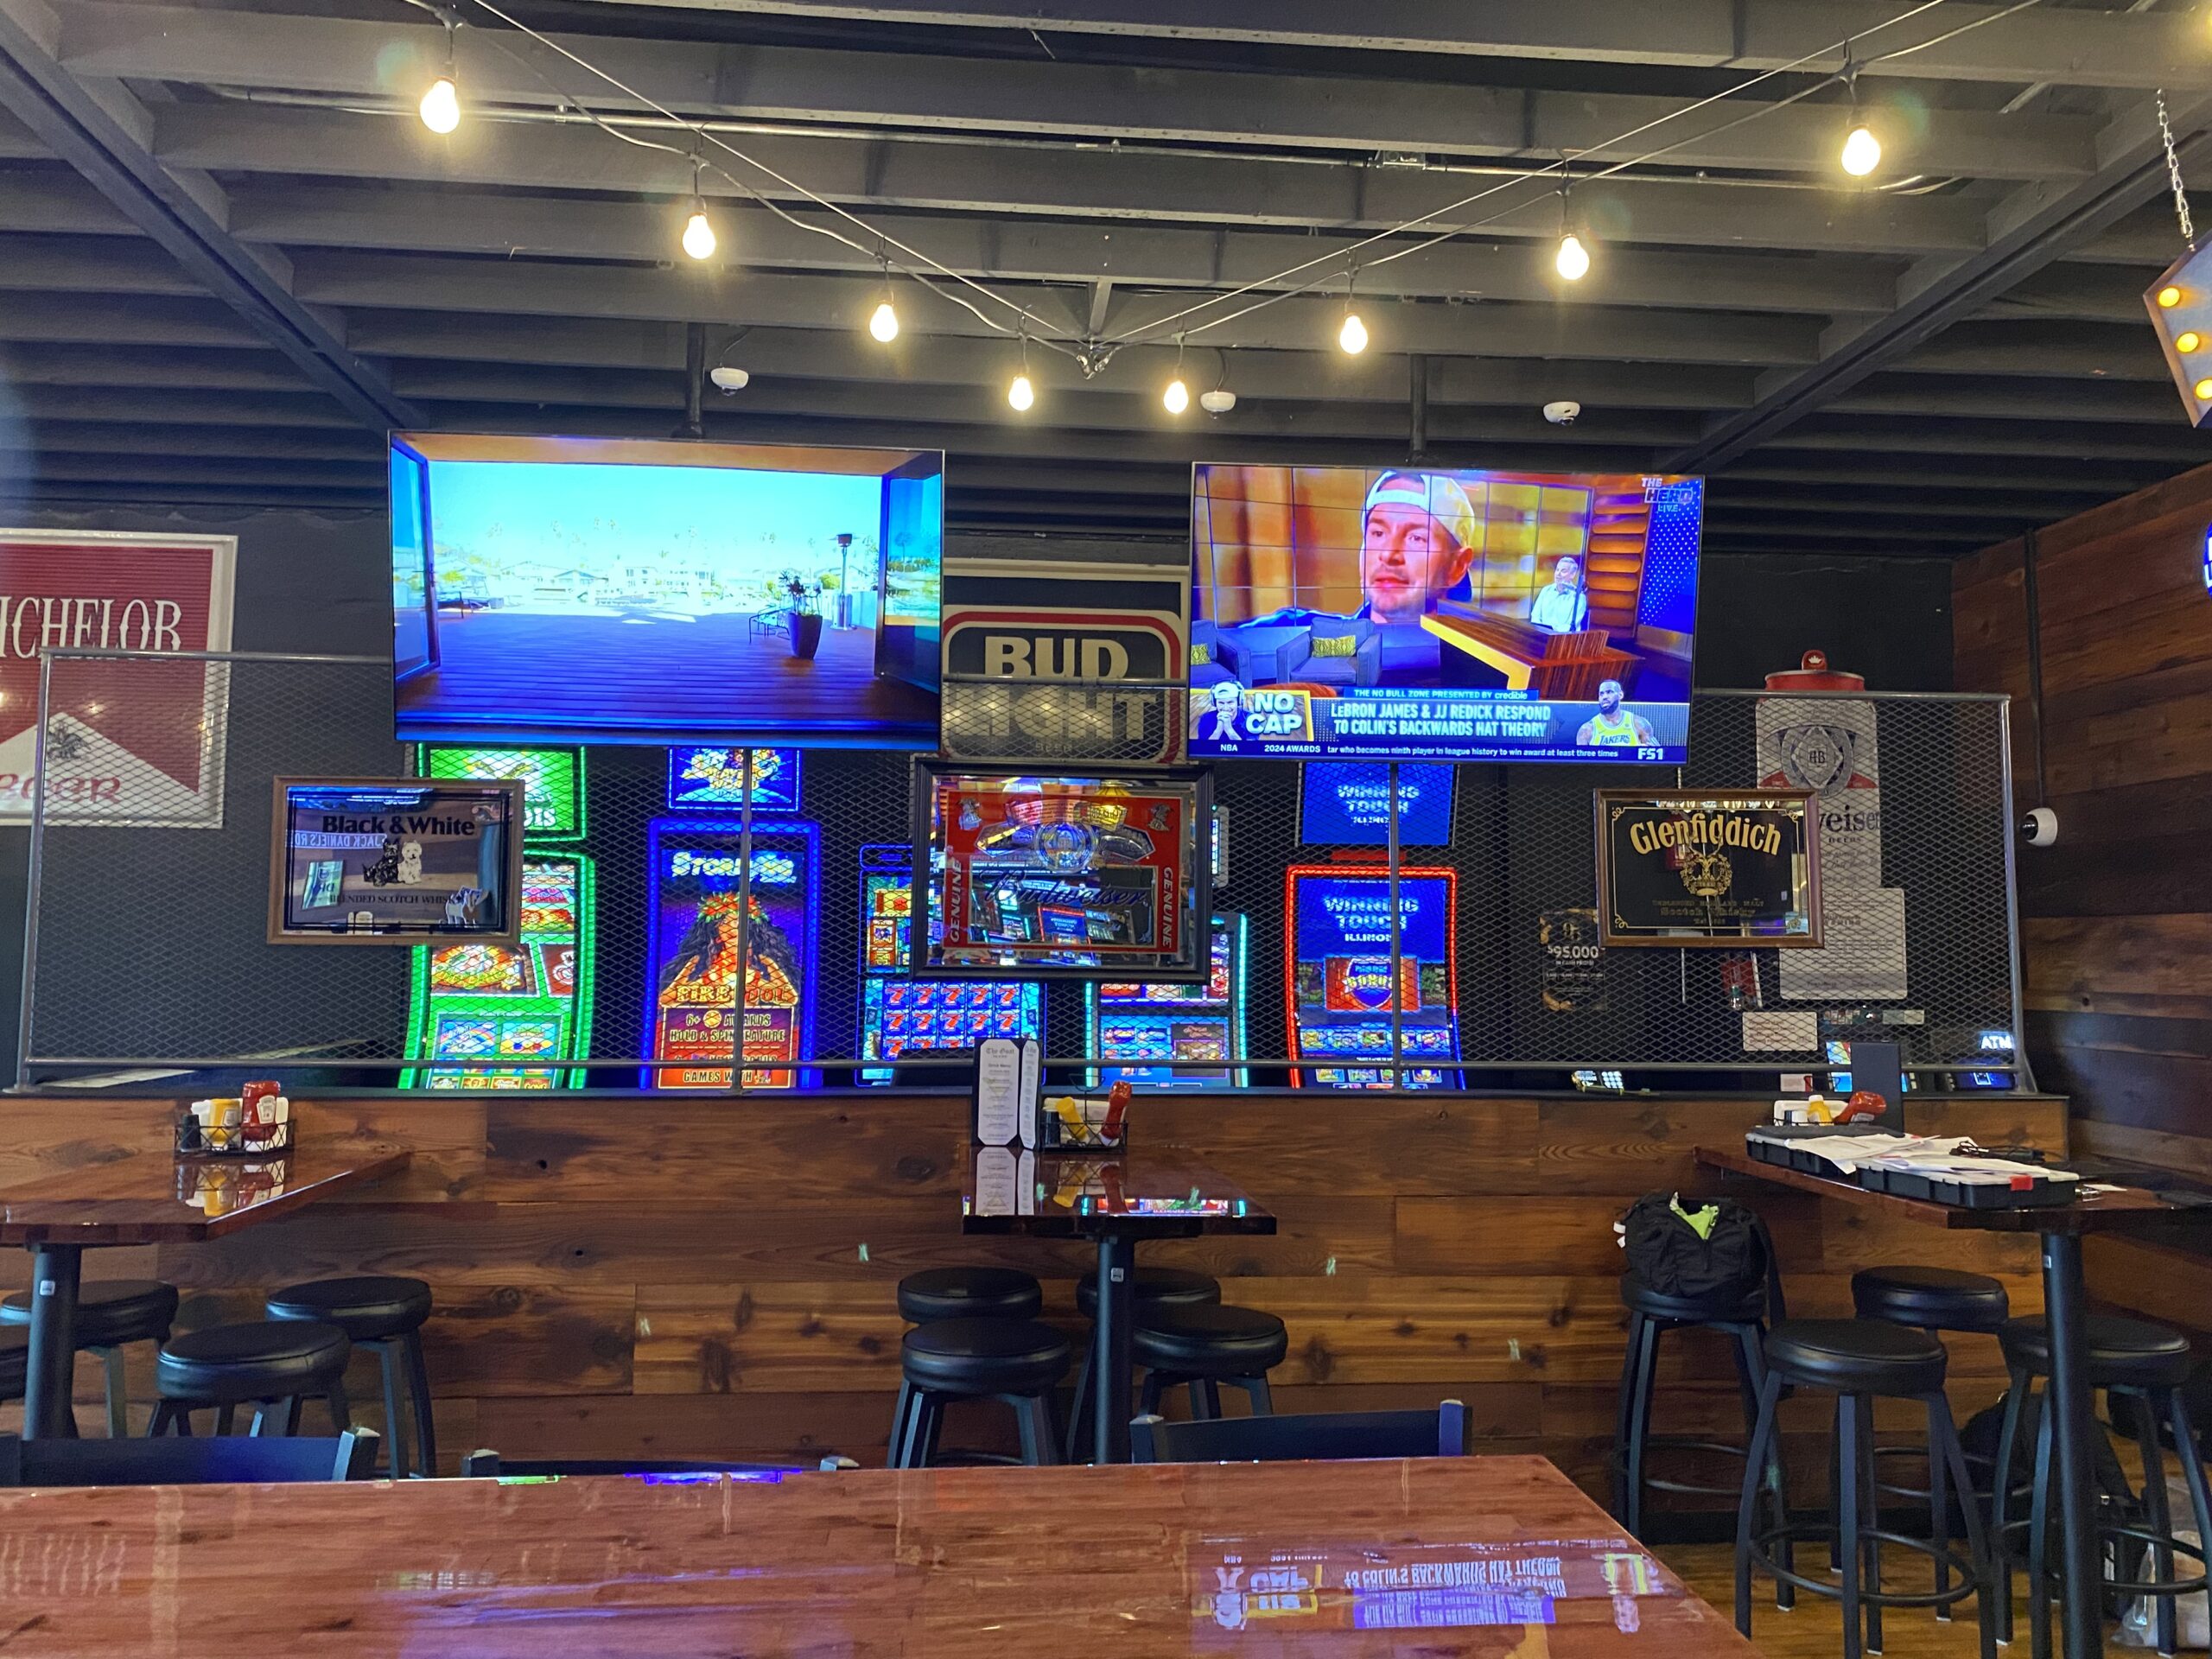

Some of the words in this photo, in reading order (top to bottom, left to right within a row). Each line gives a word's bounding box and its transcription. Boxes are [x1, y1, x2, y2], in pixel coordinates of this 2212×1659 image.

[1642, 478, 1662, 487] THE
[1644, 487, 1693, 504] HERD
[984, 636, 1128, 680] BUD
[1255, 692, 1294, 713] NO
[1432, 690, 1480, 699] PRESENTED
[1495, 691, 1528, 701] credible
[1378, 703, 1419, 719] JAMES
[1421, 704, 1431, 719] &
[1434, 704, 1447, 719] JJ
[1450, 704, 1493, 720] REDICK
[1495, 705, 1551, 721] RESPOND
[1246, 714, 1302, 734] CAP
[1333, 720, 1349, 734] TO
[1351, 720, 1397, 735] COLIN'S
[1399, 721, 1474, 736] BACKWARDS
[1476, 721, 1499, 737] HAT
[1501, 722, 1548, 737] THEORY
[1600, 734, 1630, 744] LAKERS
[1412, 747, 1434, 756] player
[1445, 747, 1471, 757] league
[1471, 748, 1497, 757] history
[1523, 748, 1546, 757] award
[1598, 749, 1618, 758] times
[1637, 748, 1663, 760] FS1
[322, 816, 385, 835] Black
[389, 817, 404, 835] &
[406, 817, 475, 836] White
[1630, 812, 1782, 855] Glenfiddich
[979, 869, 1147, 906] Budweiser
[378, 895, 418, 904] SCOTCH
[950, 860, 962, 943] GENUINE
[1163, 865, 1174, 949] GENUINE
[1344, 933, 1392, 942] ILLINOI
[676, 985, 731, 1002] FIRE
[744, 1029, 785, 1042] EATURE
[1981, 1035, 2013, 1050] ATM
[683, 1071, 721, 1083] GAMES
[724, 1071, 752, 1083] WTH
